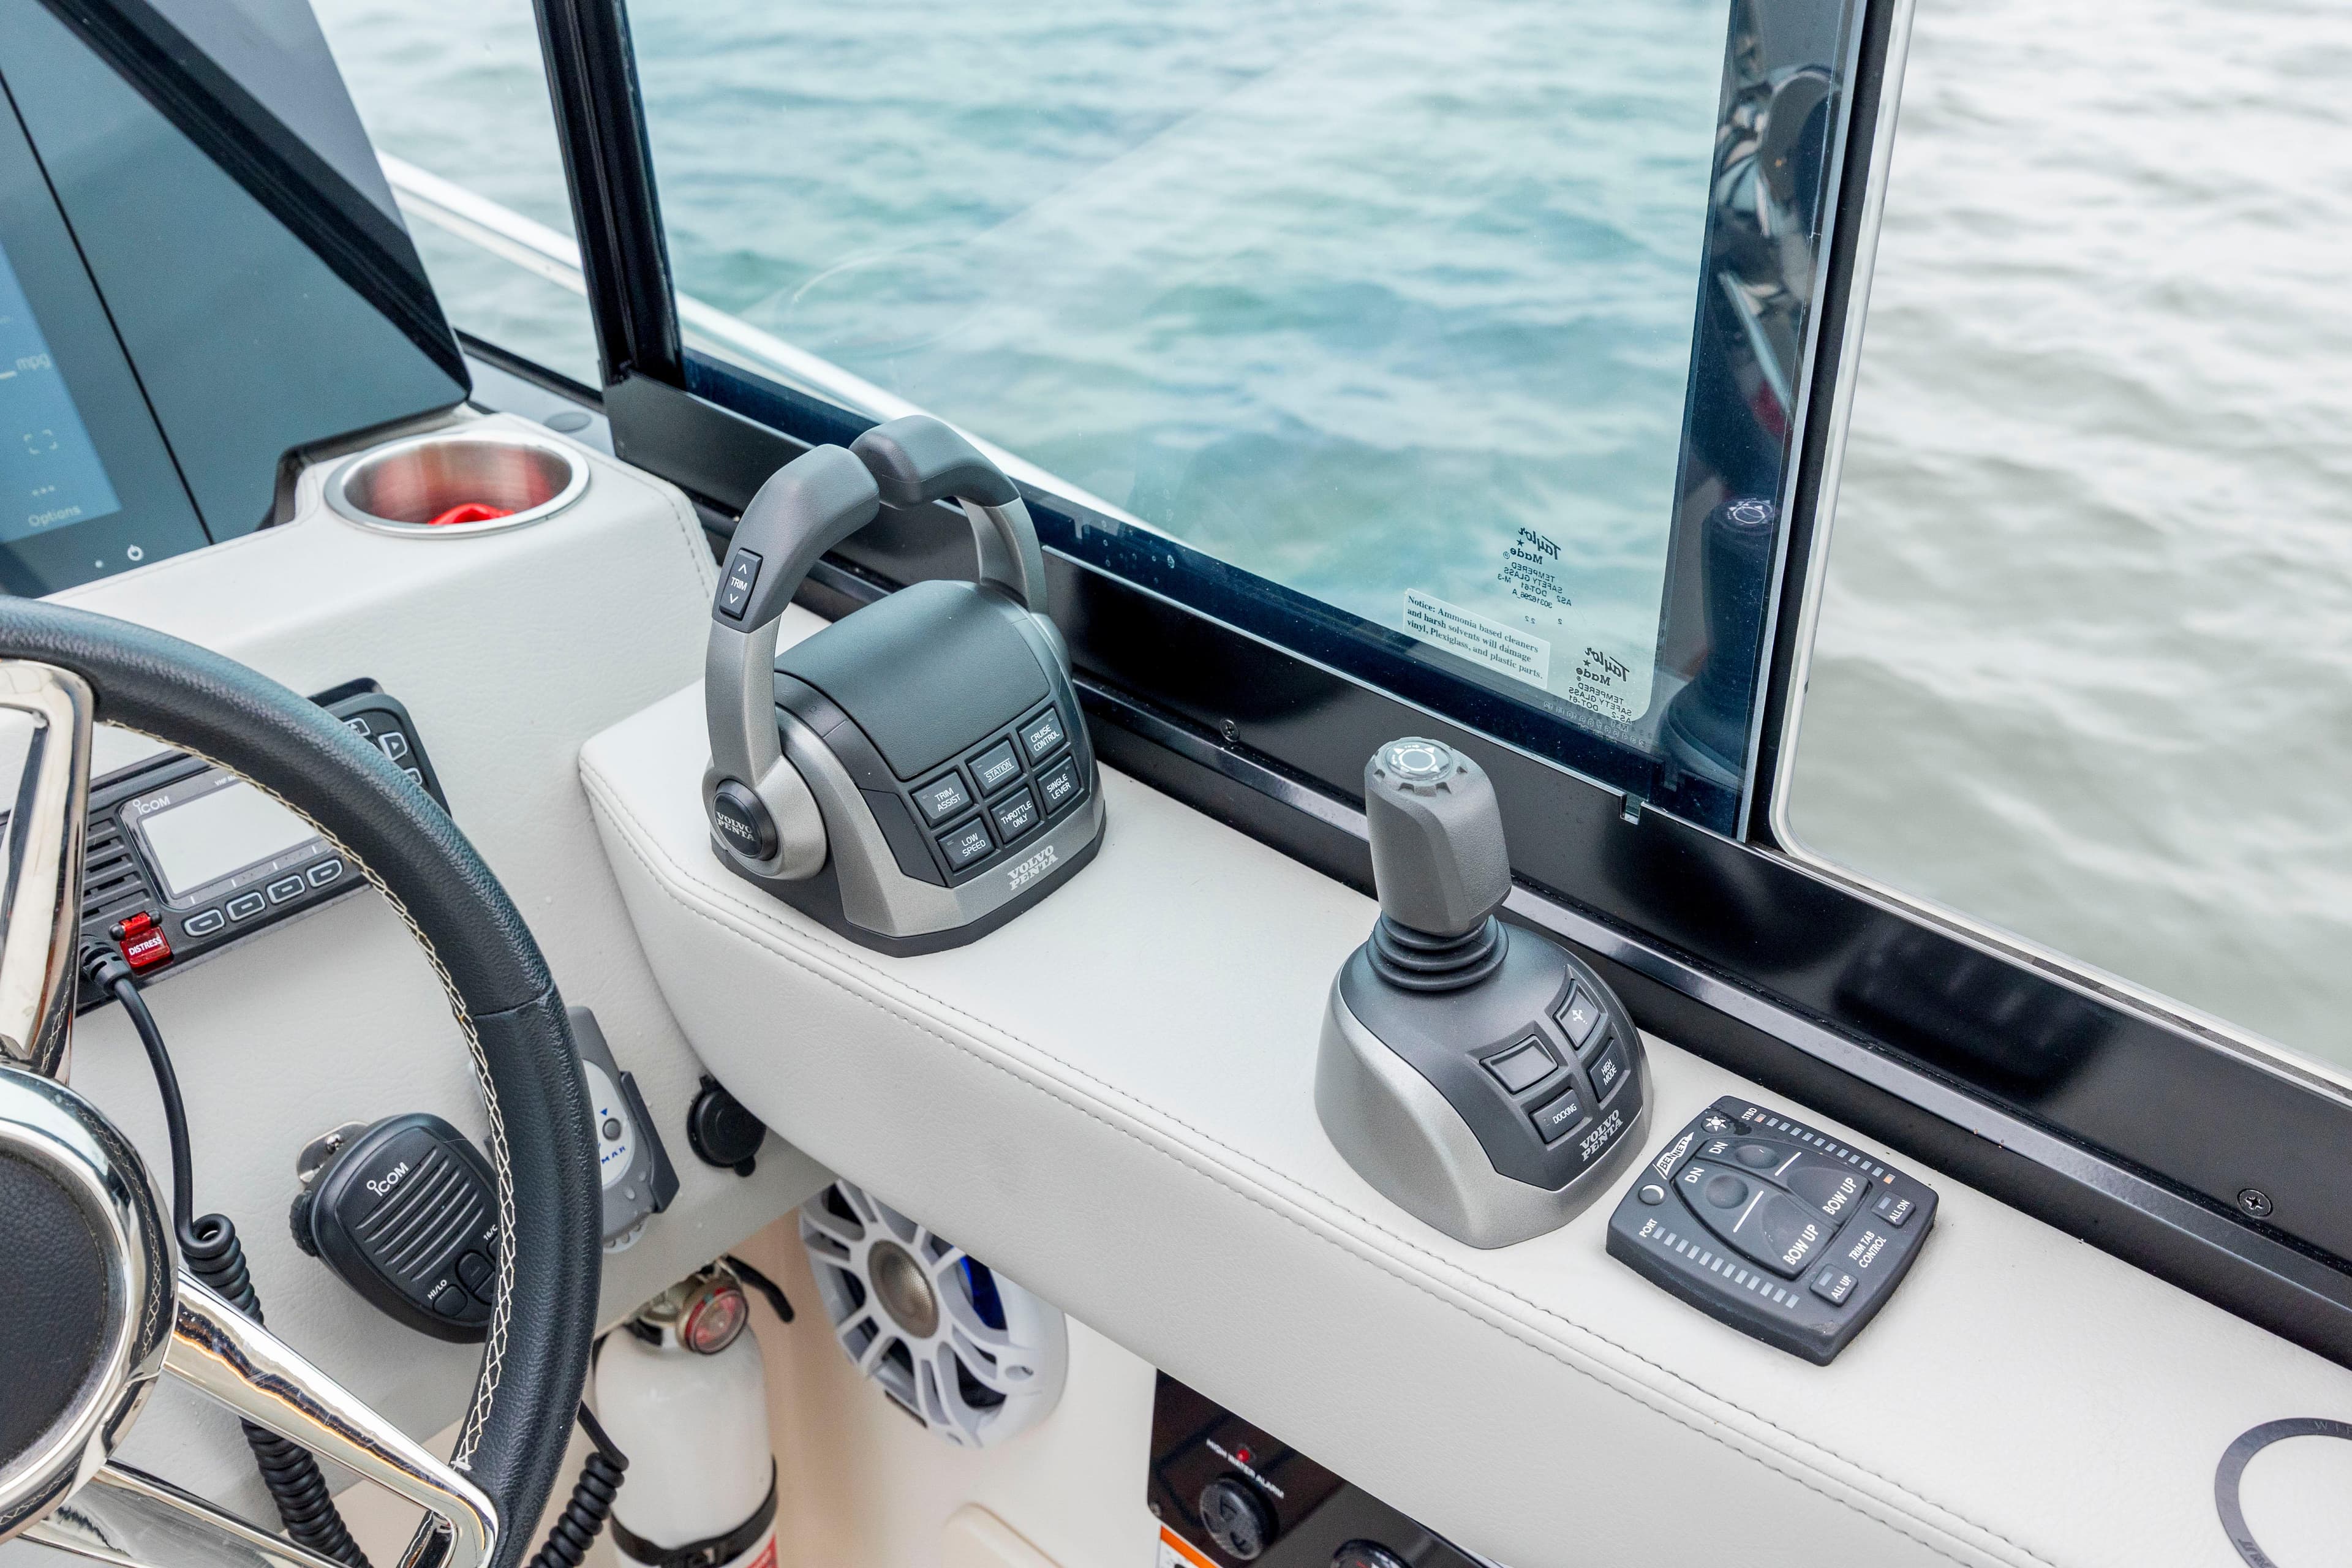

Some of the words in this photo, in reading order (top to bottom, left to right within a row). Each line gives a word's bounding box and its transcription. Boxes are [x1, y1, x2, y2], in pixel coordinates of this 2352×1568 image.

[15, 352, 50, 371] mpg
[28, 505, 82, 527] Options
[731, 576, 747, 591] TRIM
[1408, 595, 1435, 612] Notice:
[1438, 608, 1477, 629] Ammonia
[1479, 623, 1502, 639] based
[1504, 634, 1539, 653] cleaners
[1408, 608, 1422, 619] and
[1424, 613, 1446, 629] harsh
[1449, 624, 1480, 642] solvents
[1483, 638, 1497, 649] will
[1499, 644, 1531, 663] damage
[1408, 619, 1428, 635] vinyl,
[1430, 627, 1471, 651] Plexiglass,
[1472, 646, 1488, 657] and
[1490, 652, 1517, 669] plastic
[1519, 664, 1543, 679] parts.
[1030, 724, 1052, 743] CRUISE
[1033, 731, 1060, 752] CONTROL
[985, 760, 1013, 780] STATION
[1046, 774, 1068, 793] SINGLE
[1051, 782, 1071, 799] LEVER
[935, 787, 954, 802] TRIM
[937, 794, 961, 812] ASSIST
[715, 811, 753, 834] VOLVO
[1000, 801, 1032, 824] THROTTLE
[1012, 815, 1028, 828] ONLY
[717, 818, 755, 842] PENTA
[962, 832, 978, 846] LOW
[962, 839, 986, 857] SPEED
[1008, 845, 1054, 880] VOLVO
[1009, 858, 1058, 891] PENTA
[129, 936, 162, 956] DISTRESS
[1601, 1058, 1613, 1076] HIGH
[1603, 1067, 1617, 1086] MODE
[1553, 1103, 1578, 1125] DOCKING
[1741, 1107, 1757, 1121] STBD
[1579, 1109, 1619, 1148] VOLVO
[1581, 1118, 1623, 1161] PENTA
[1708, 1141, 1728, 1155] DN
[1660, 1138, 1687, 1170] BENNETT
[1684, 1167, 1705, 1183] DN
[1822, 1191, 1847, 1215] BOW
[1841, 1177, 1856, 1193] UP
[1889, 1210, 1902, 1223] ALL
[1897, 1199, 1910, 1213] DN
[1638, 1218, 1658, 1237] PORT
[1783, 1238, 1809, 1265] BOW
[1802, 1224, 1819, 1242] UP
[1849, 1241, 1866, 1261] TRIM
[1860, 1231, 1875, 1246] TAB
[1859, 1236, 1887, 1268] CONTROL
[428, 1280, 447, 1300] HI/LO
[1831, 1286, 1845, 1299] ALL
[1839, 1275, 1852, 1288] UP
